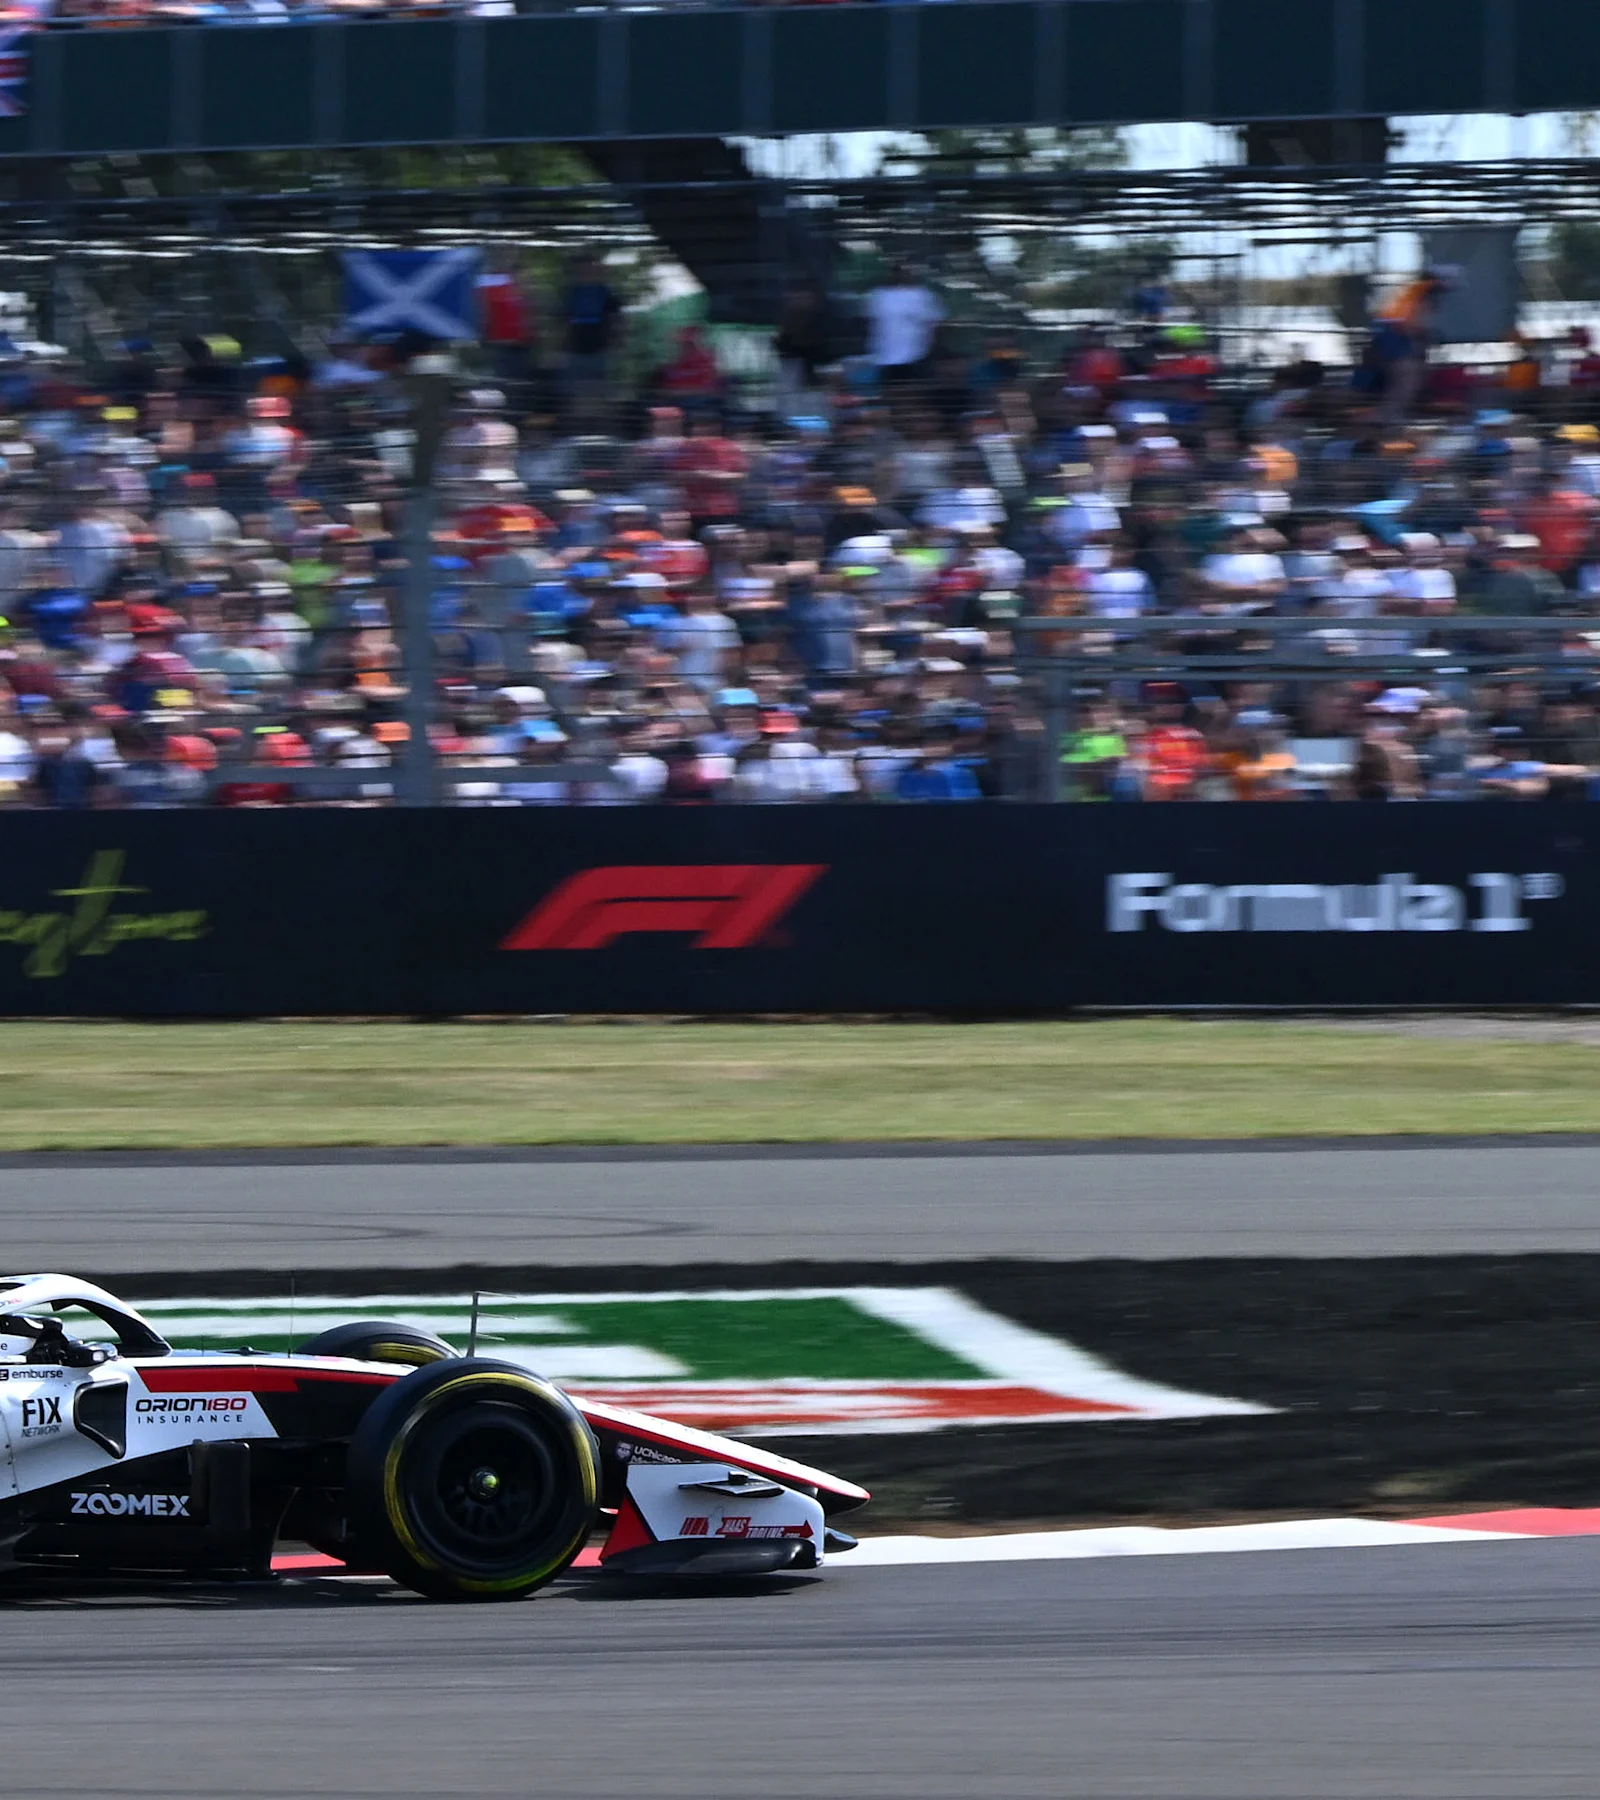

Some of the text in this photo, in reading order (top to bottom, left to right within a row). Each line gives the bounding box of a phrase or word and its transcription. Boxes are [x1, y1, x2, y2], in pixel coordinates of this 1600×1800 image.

[1105, 872, 1463, 932] Formula
[12, 1369, 63, 1379] emburse
[22, 1397, 62, 1427] FIX
[135, 1398, 247, 1412] ORION180
[138, 1415, 243, 1424] INSURANCE
[21, 1424, 60, 1437] NETWORK
[71, 1493, 190, 1516] ZOOMEX
[722, 1519, 747, 1533] HAAS
